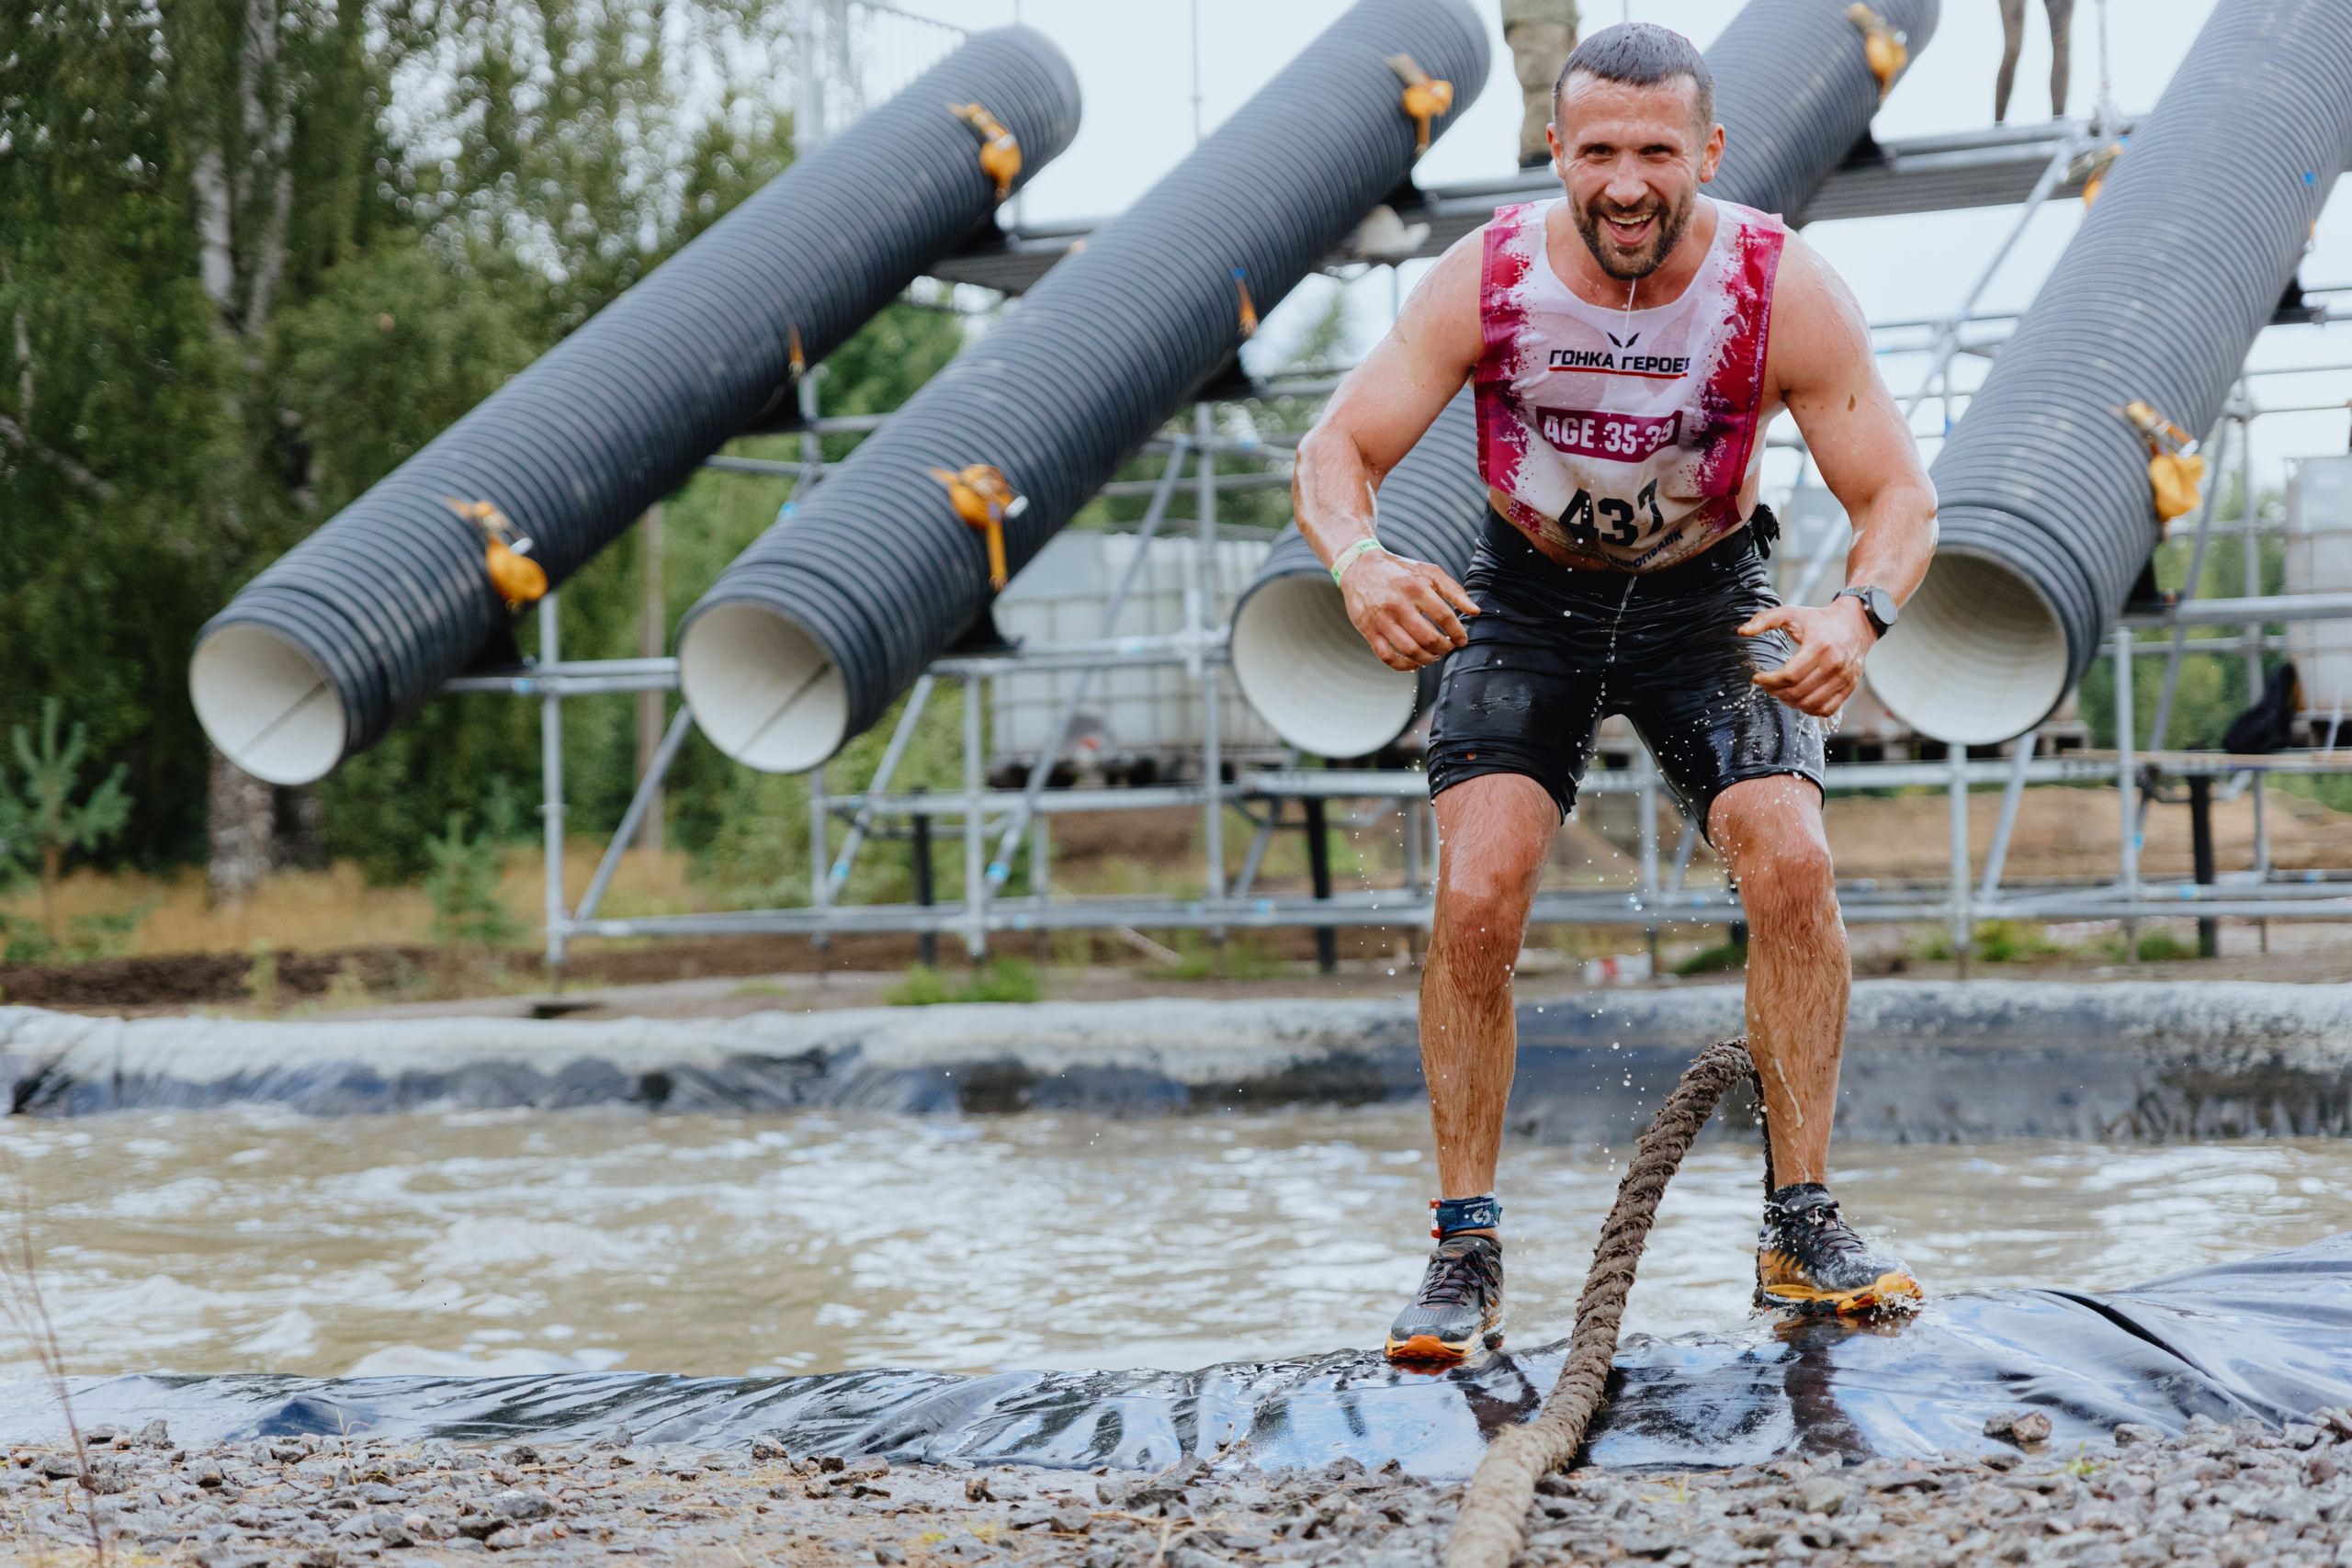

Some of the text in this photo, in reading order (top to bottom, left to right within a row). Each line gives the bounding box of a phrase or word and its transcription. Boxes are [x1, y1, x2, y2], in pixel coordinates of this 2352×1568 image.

[1549, 350, 1614, 369] ГОНКА
[1544, 415, 1676, 455] AGE 35-39
[1558, 478, 1664, 547] 437
